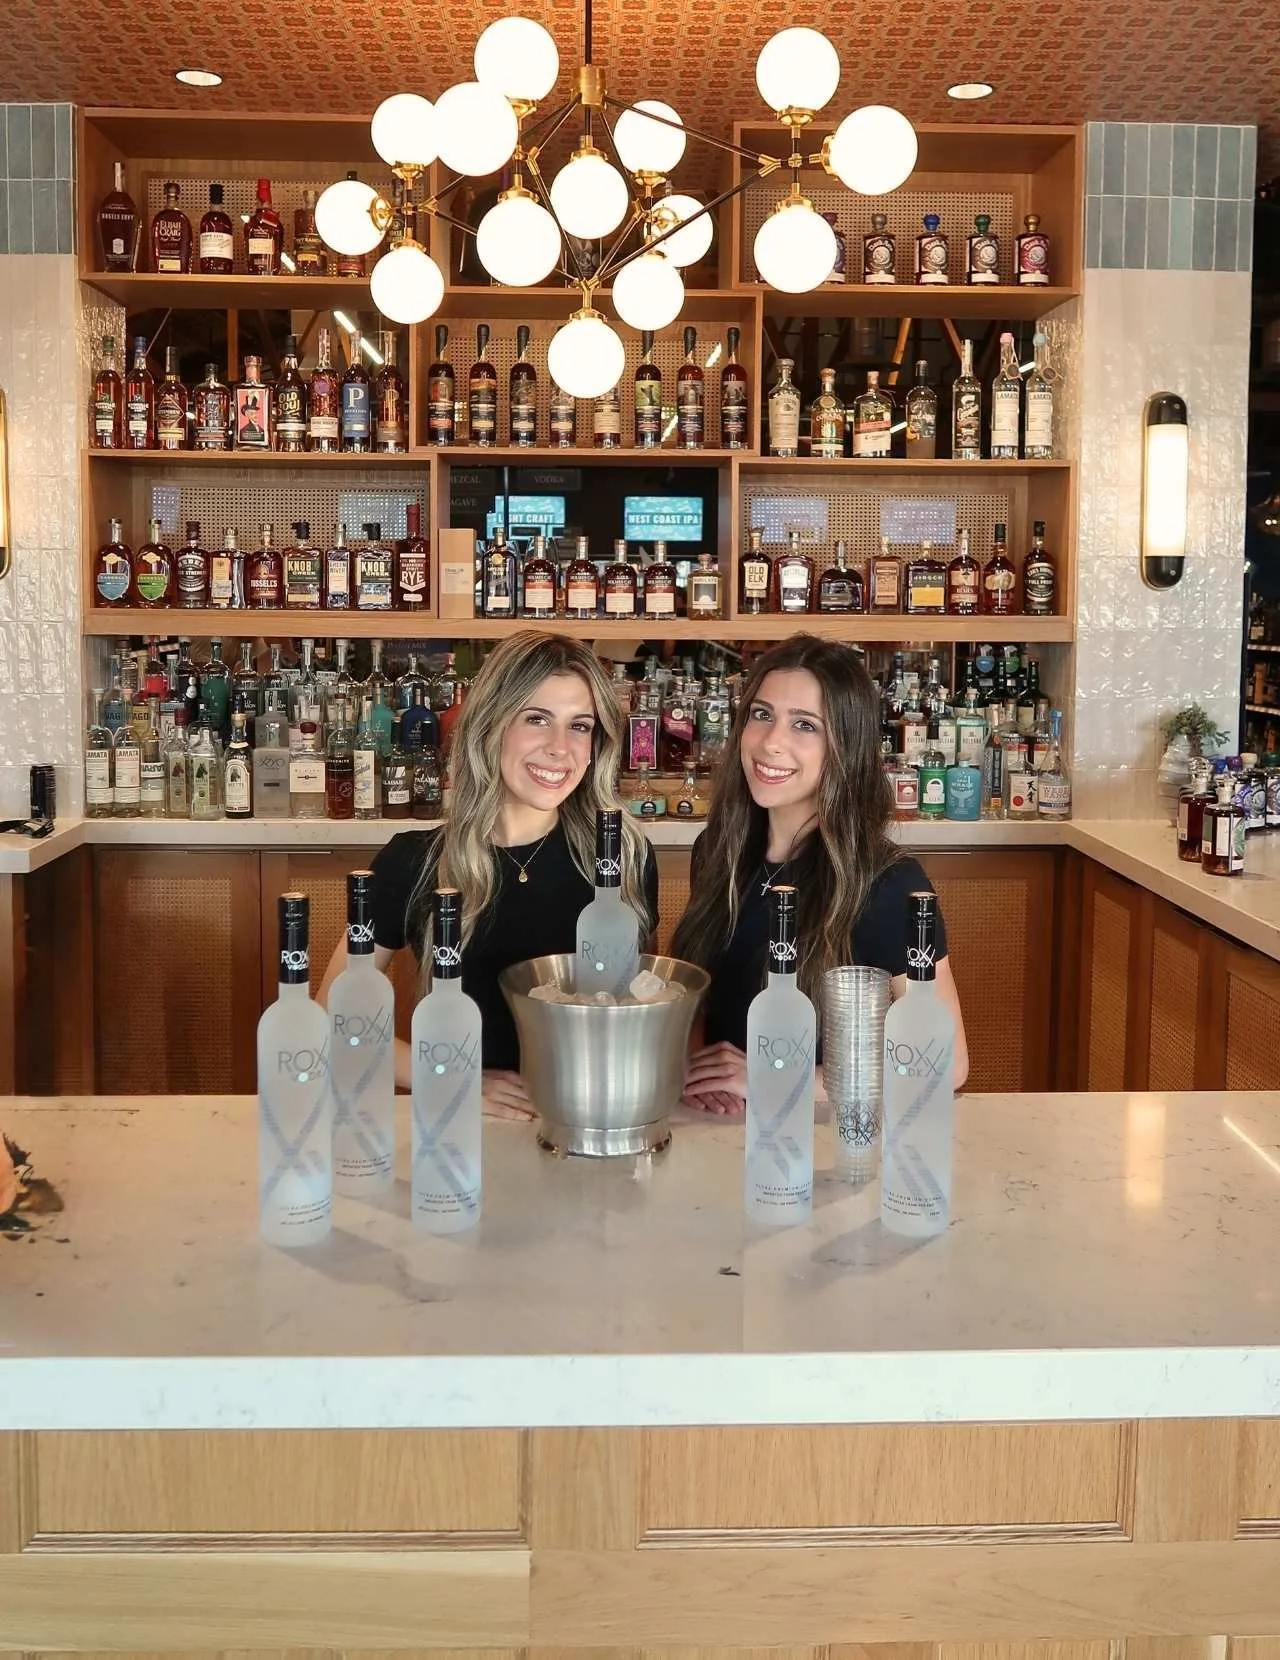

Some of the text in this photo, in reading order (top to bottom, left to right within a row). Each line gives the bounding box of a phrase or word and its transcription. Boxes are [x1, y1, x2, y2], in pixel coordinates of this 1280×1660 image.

[160, 220, 181, 228] ELIJAH
[160, 228, 181, 237] CRAIG
[498, 514, 554, 524] LGHT CRAFT
[628, 514, 699, 524] WEST COAST IPA
[288, 560, 312, 571] KNOB
[361, 561, 385, 572] KNOB
[749, 566, 765, 575] OLD
[401, 571, 425, 586] RYE
[749, 575, 764, 583] ELK
